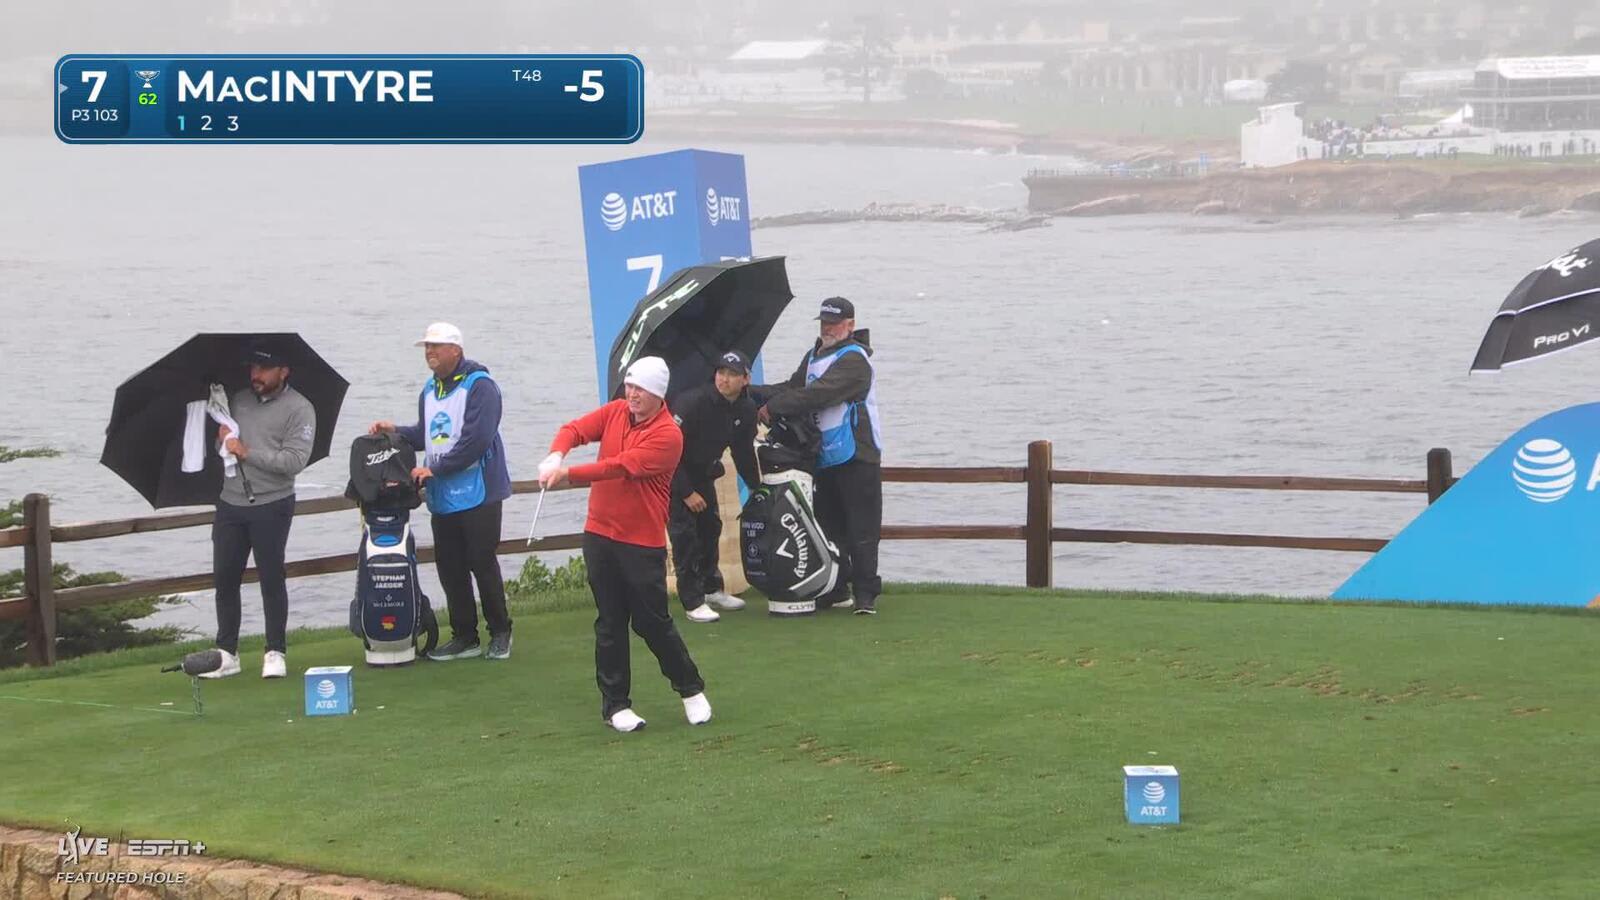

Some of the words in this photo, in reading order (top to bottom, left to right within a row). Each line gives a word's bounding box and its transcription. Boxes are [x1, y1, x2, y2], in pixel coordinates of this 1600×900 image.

[630, 190, 677, 220] AT&T
[719, 196, 741, 221] AT&T
[780, 512, 809, 578] Callaway
[371, 574, 406, 582] STEPHAN
[315, 699, 339, 709] AT&T
[1140, 805, 1168, 816] AT&T
